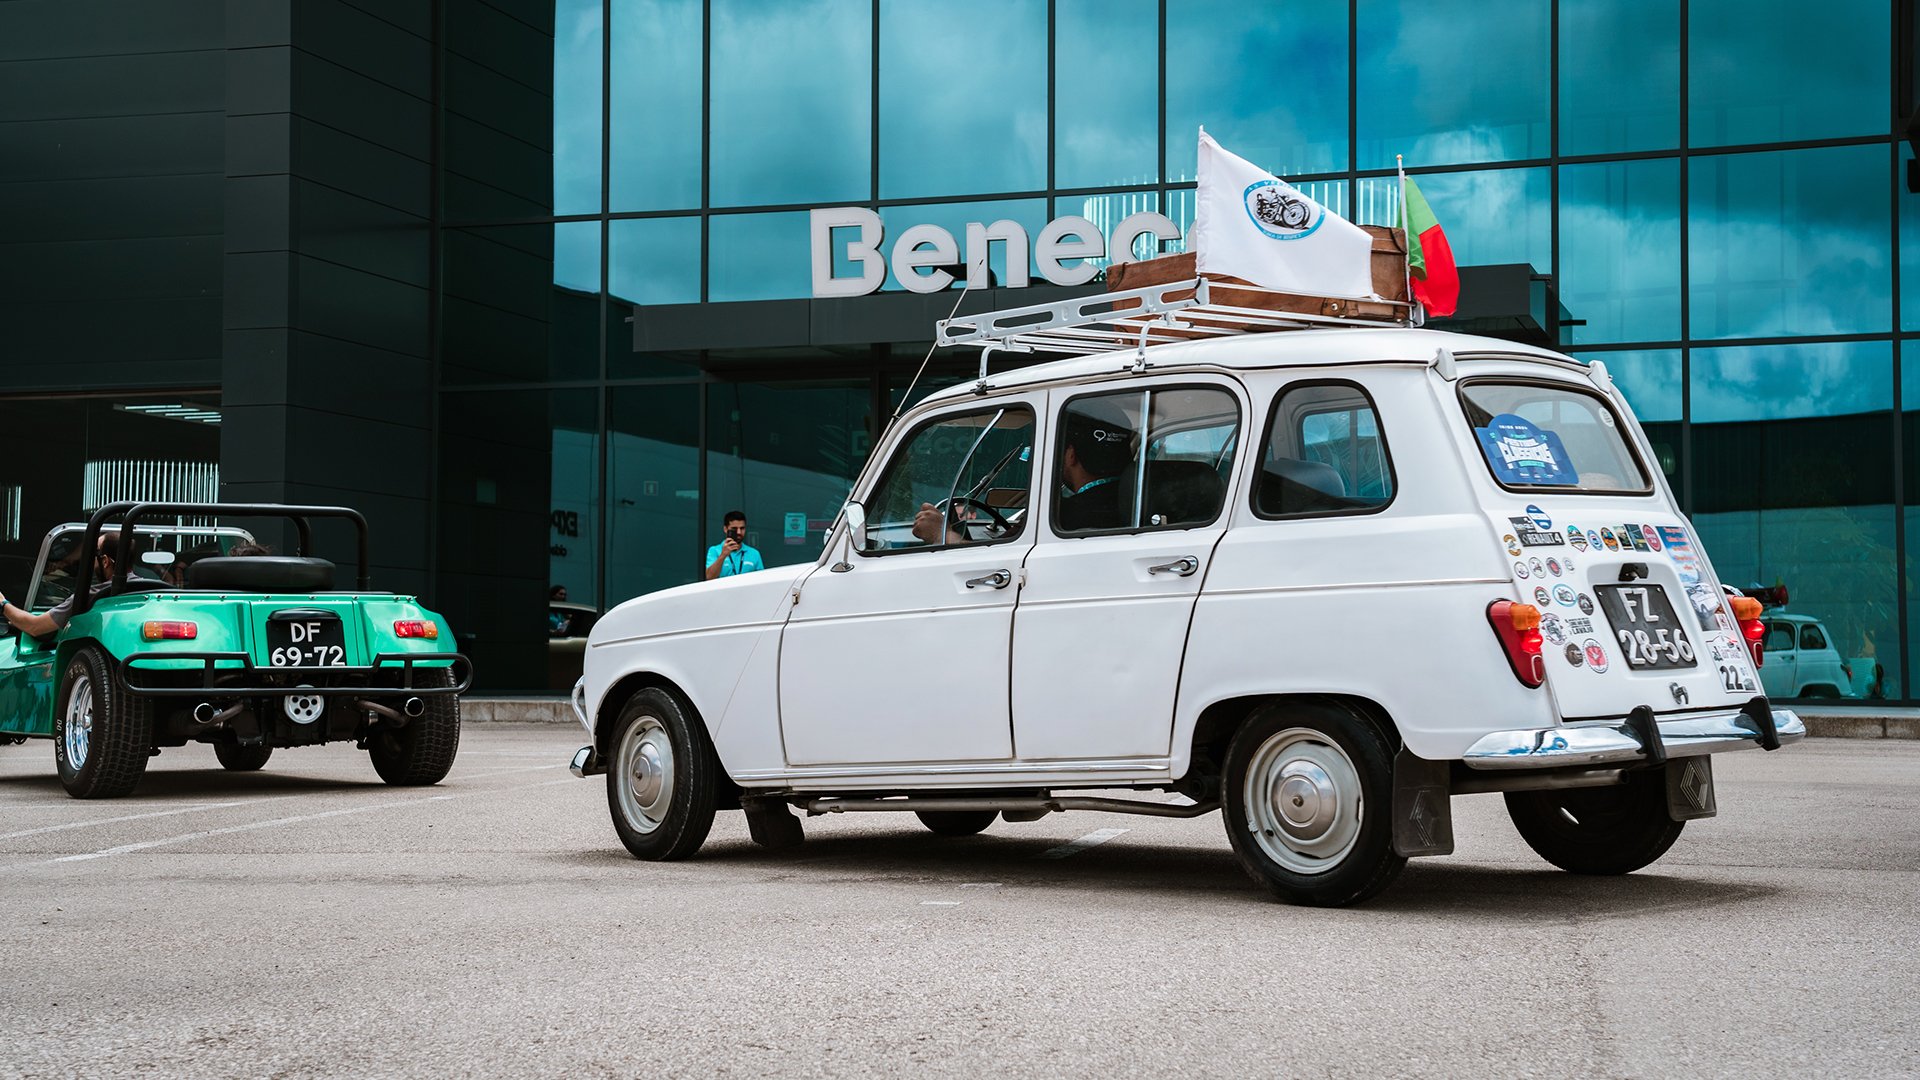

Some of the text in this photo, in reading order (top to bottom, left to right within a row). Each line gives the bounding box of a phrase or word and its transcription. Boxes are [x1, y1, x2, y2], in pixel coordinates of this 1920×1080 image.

[810, 206, 1198, 297] Benec
[1526, 533, 1556, 545] RENAULT
[1554, 533, 1562, 543] 4
[1616, 587, 1660, 622] FZ
[290, 622, 321, 643] DF
[271, 645, 346, 667] 69-72
[1618, 628, 1694, 665] 28-56
[1719, 665, 1744, 690] 22
